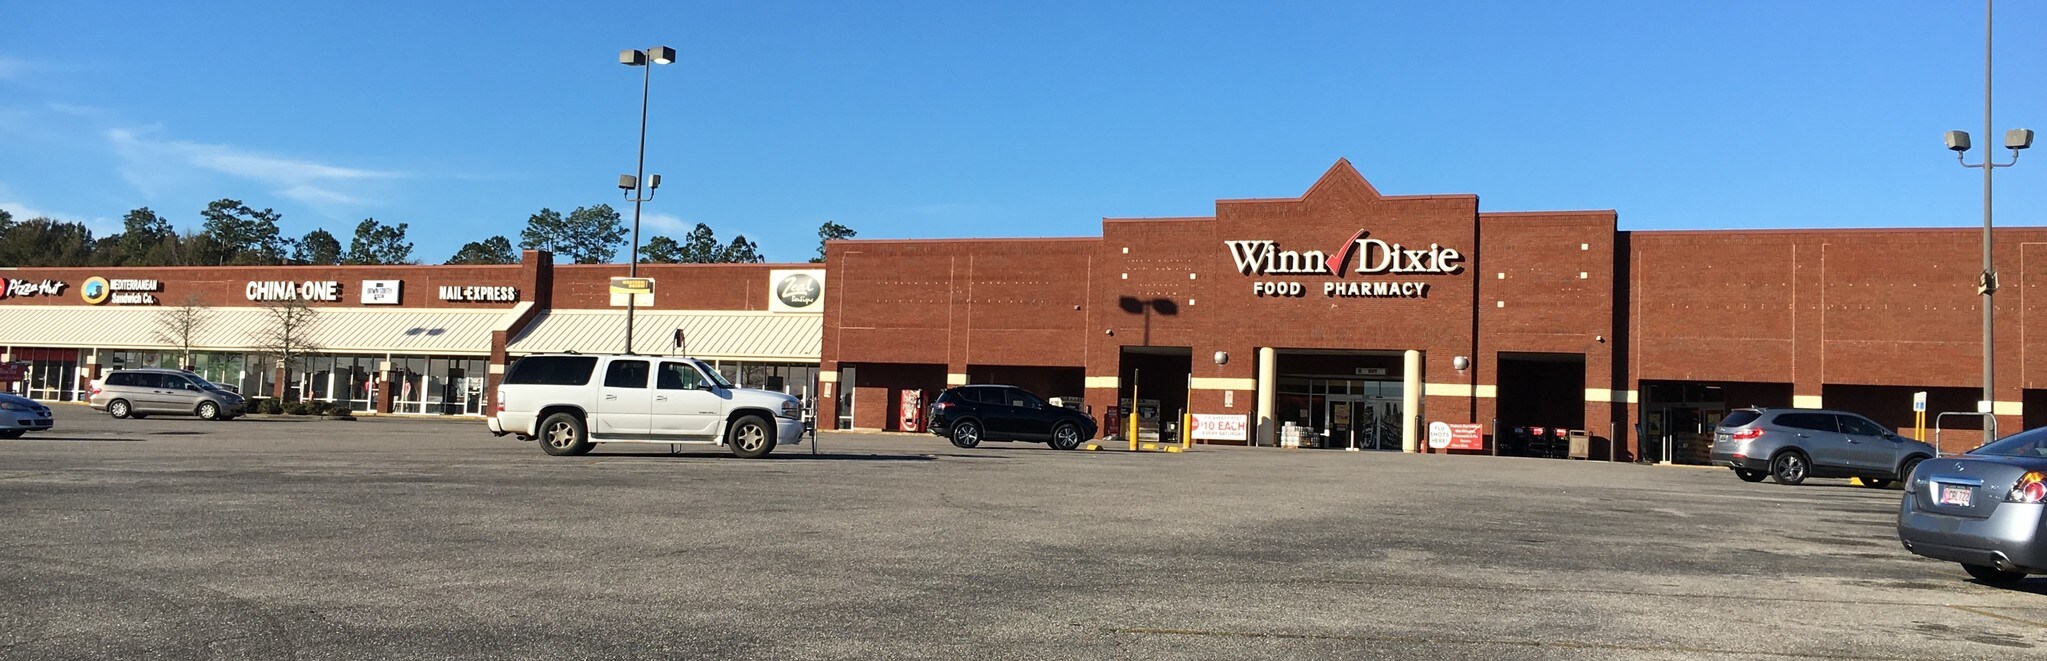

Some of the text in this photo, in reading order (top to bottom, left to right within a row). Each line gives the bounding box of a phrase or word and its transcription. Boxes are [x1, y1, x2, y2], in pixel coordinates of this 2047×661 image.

[1224, 237, 1460, 274] Winn Dixie
[6, 278, 64, 297] Pizza Hut
[109, 278, 158, 291] MEDITERRANEAN
[781, 276, 815, 299] Zeal
[1253, 281, 1426, 297] FOOD PHARMACY
[111, 292, 154, 304] Sandwich Co.
[1218, 421, 1245, 431] EACH
